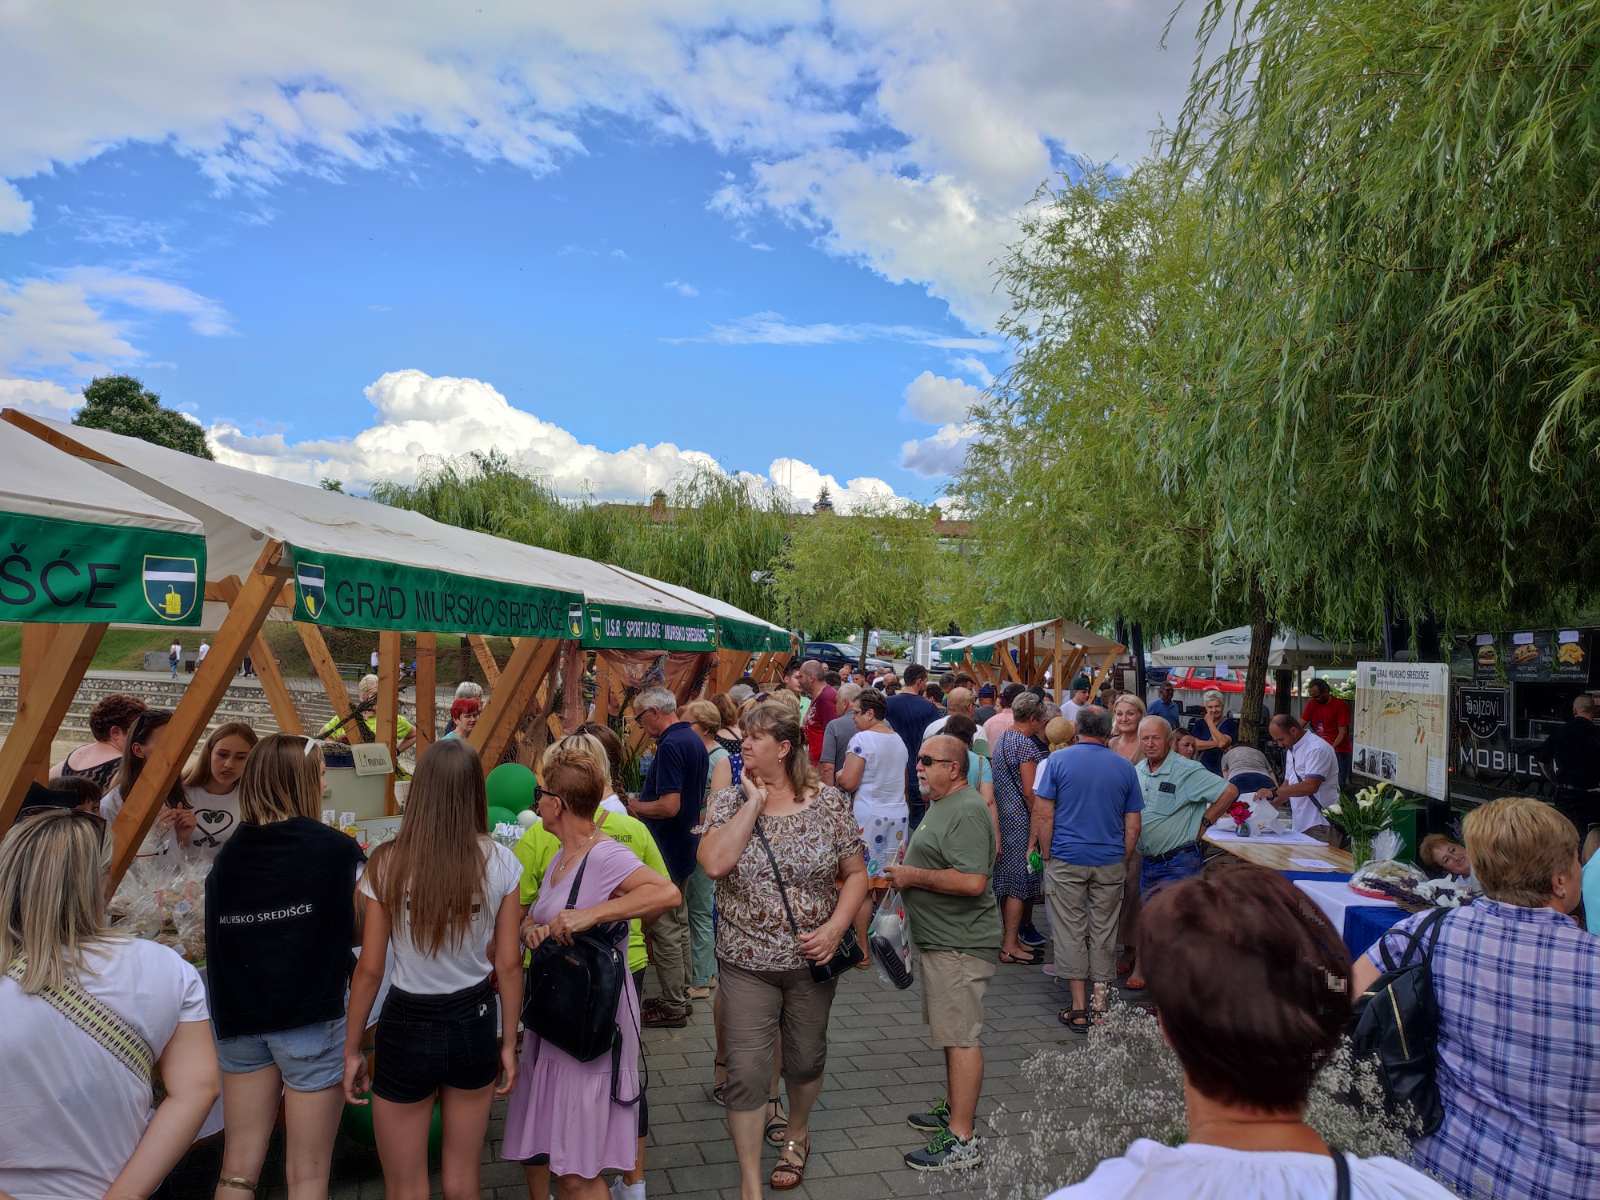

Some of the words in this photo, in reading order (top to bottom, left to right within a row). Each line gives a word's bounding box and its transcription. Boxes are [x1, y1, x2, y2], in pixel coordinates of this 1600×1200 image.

[335, 580, 406, 620] GRAD
[415, 590, 495, 626] MURSKO
[498, 598, 565, 631] SREDIŠĆE
[1460, 745, 1541, 776] MOBILE
[219, 914, 254, 925] MURSKO
